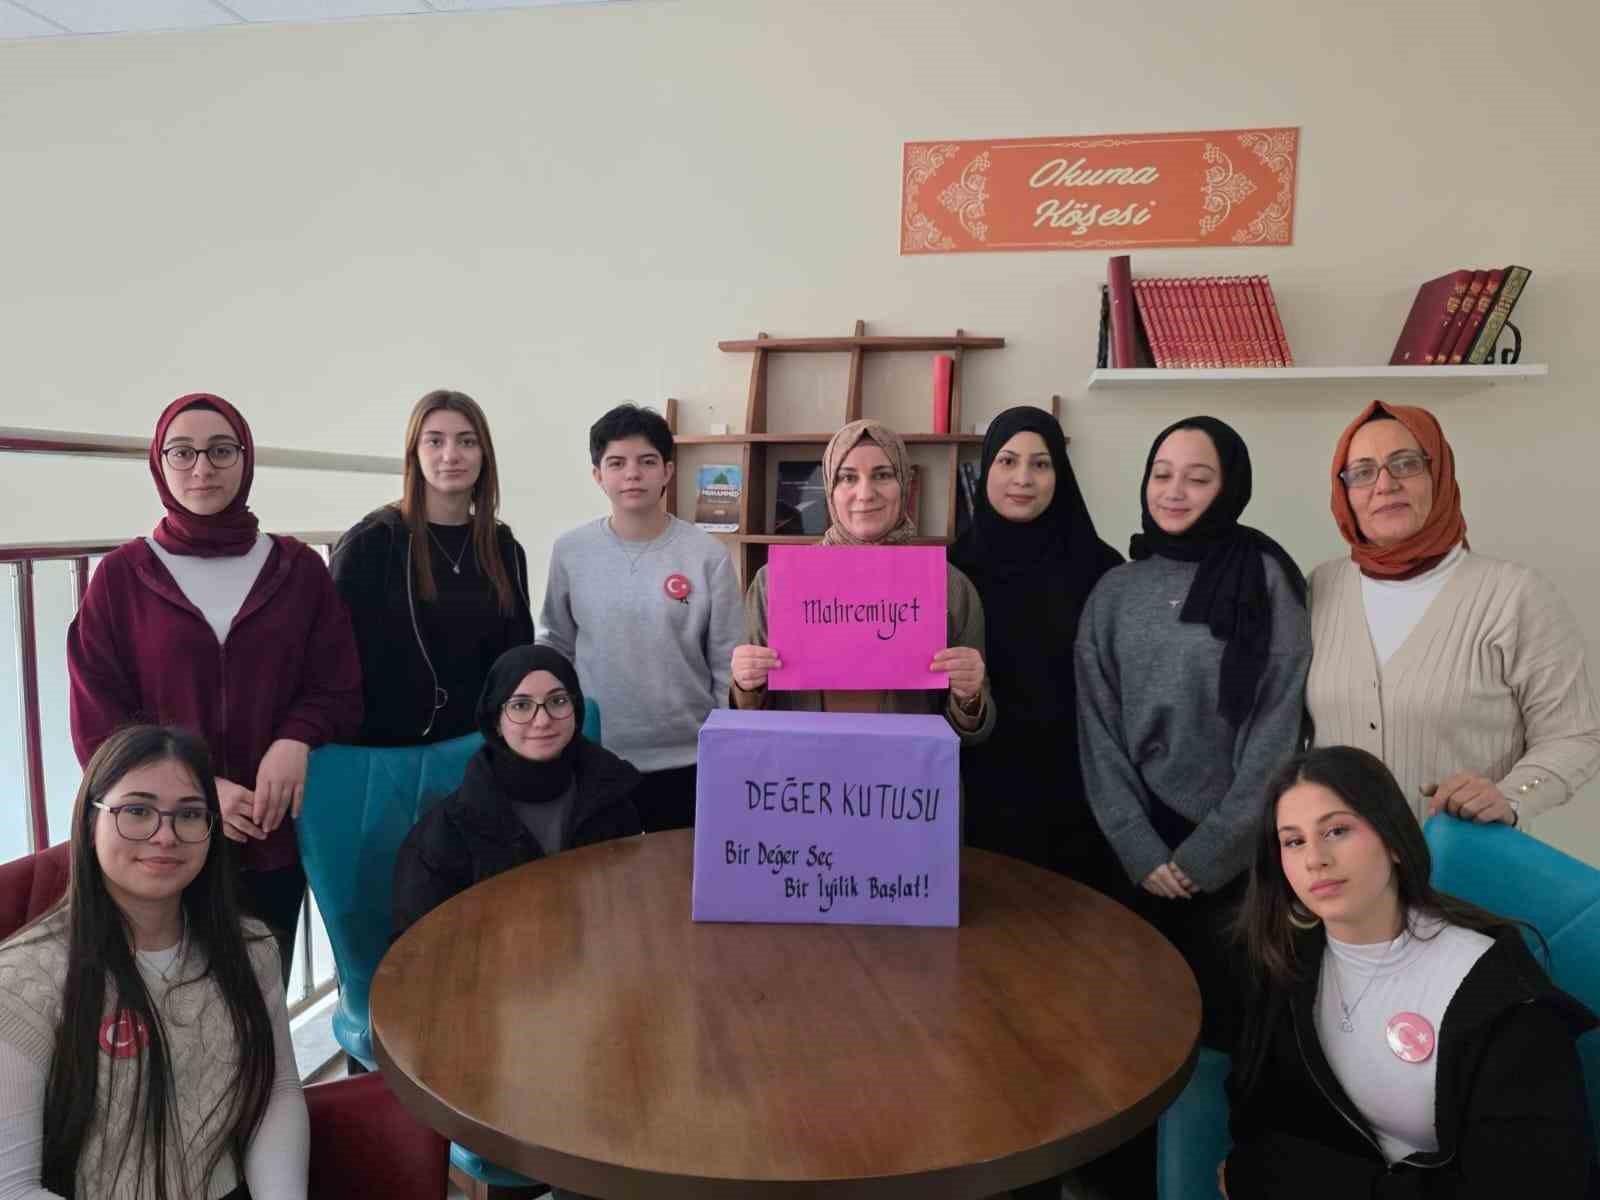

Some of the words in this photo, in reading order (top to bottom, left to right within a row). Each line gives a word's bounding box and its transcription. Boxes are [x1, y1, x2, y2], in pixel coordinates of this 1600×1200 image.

[1029, 157, 1160, 189] Okuma
[1032, 198, 1157, 235] Köşesi
[802, 597, 920, 640] Mahremiyet
[745, 777, 833, 816] DEĞER
[842, 782, 940, 822] KUTUSU
[725, 840, 751, 865] Bir
[757, 841, 799, 874] Değer
[806, 845, 833, 871] Seç
[784, 877, 809, 898] Bir
[817, 873, 858, 913] İyilik
[869, 874, 929, 903] Başlat!
